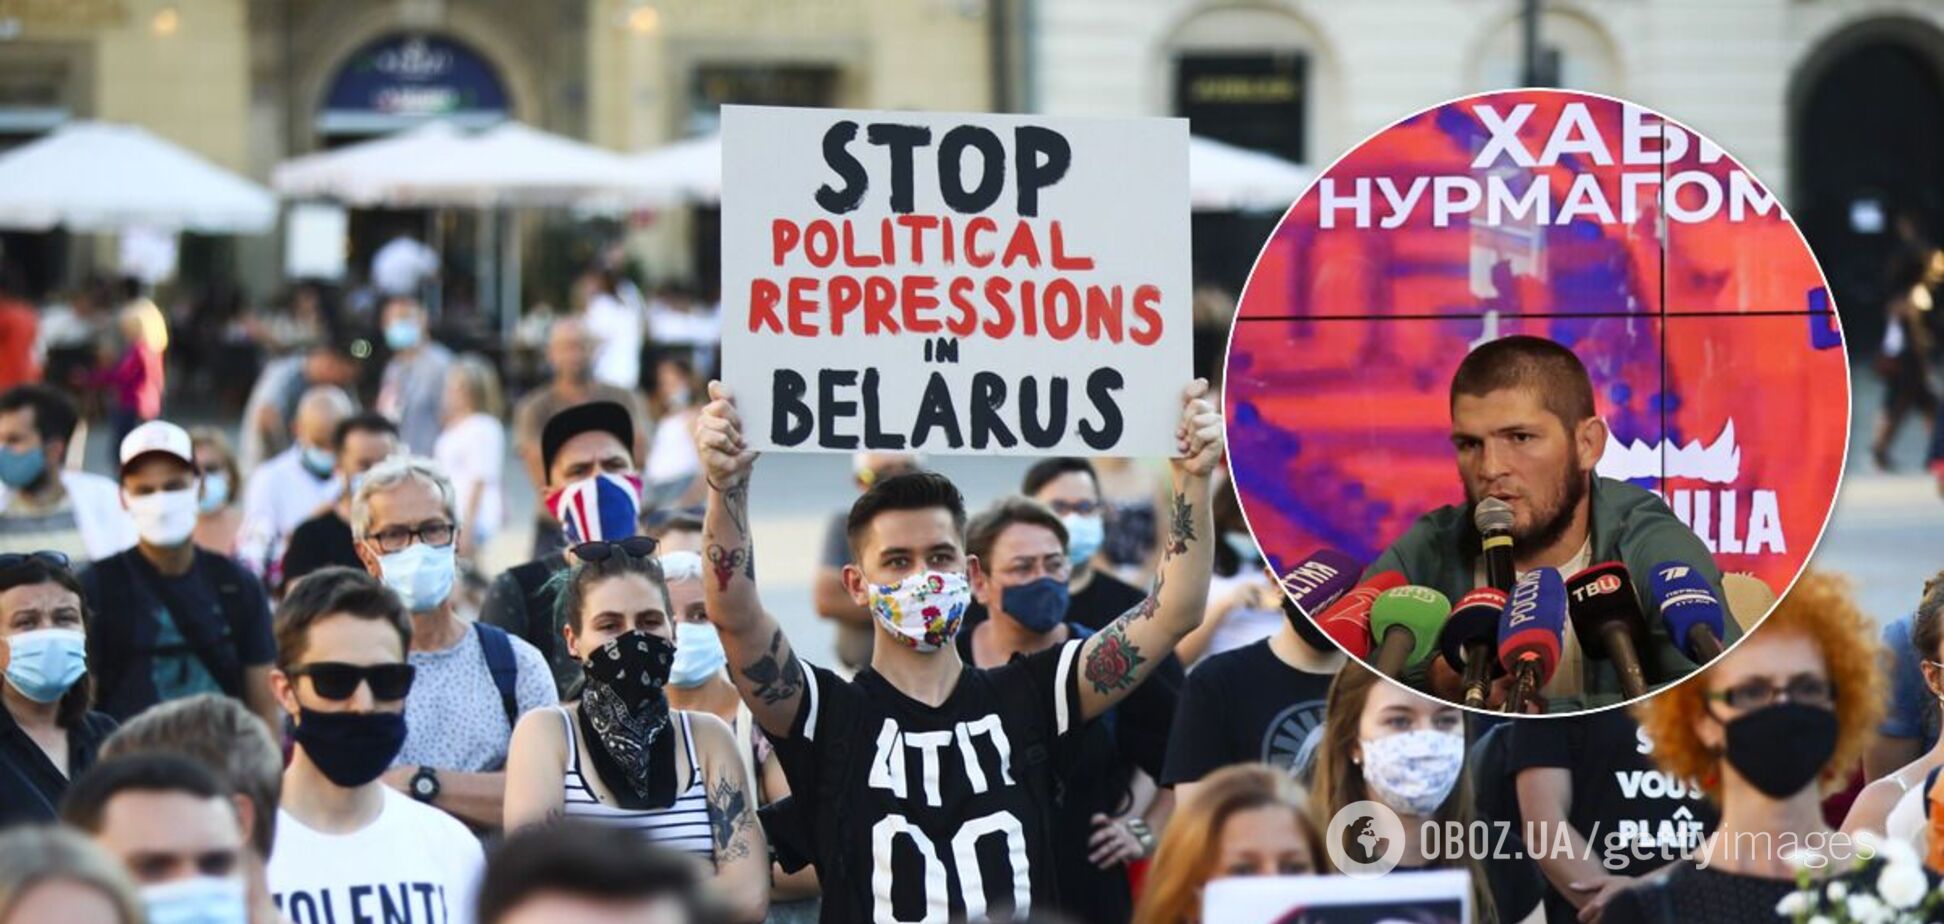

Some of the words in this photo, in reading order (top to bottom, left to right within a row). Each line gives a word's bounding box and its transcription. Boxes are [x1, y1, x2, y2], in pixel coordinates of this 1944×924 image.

[815, 120, 1072, 217] STOP
[772, 215, 1095, 270] POLITICAL
[748, 276, 1164, 346] REPRESSIONS
[924, 337, 959, 364] IN
[771, 367, 1124, 451] BELARUS
